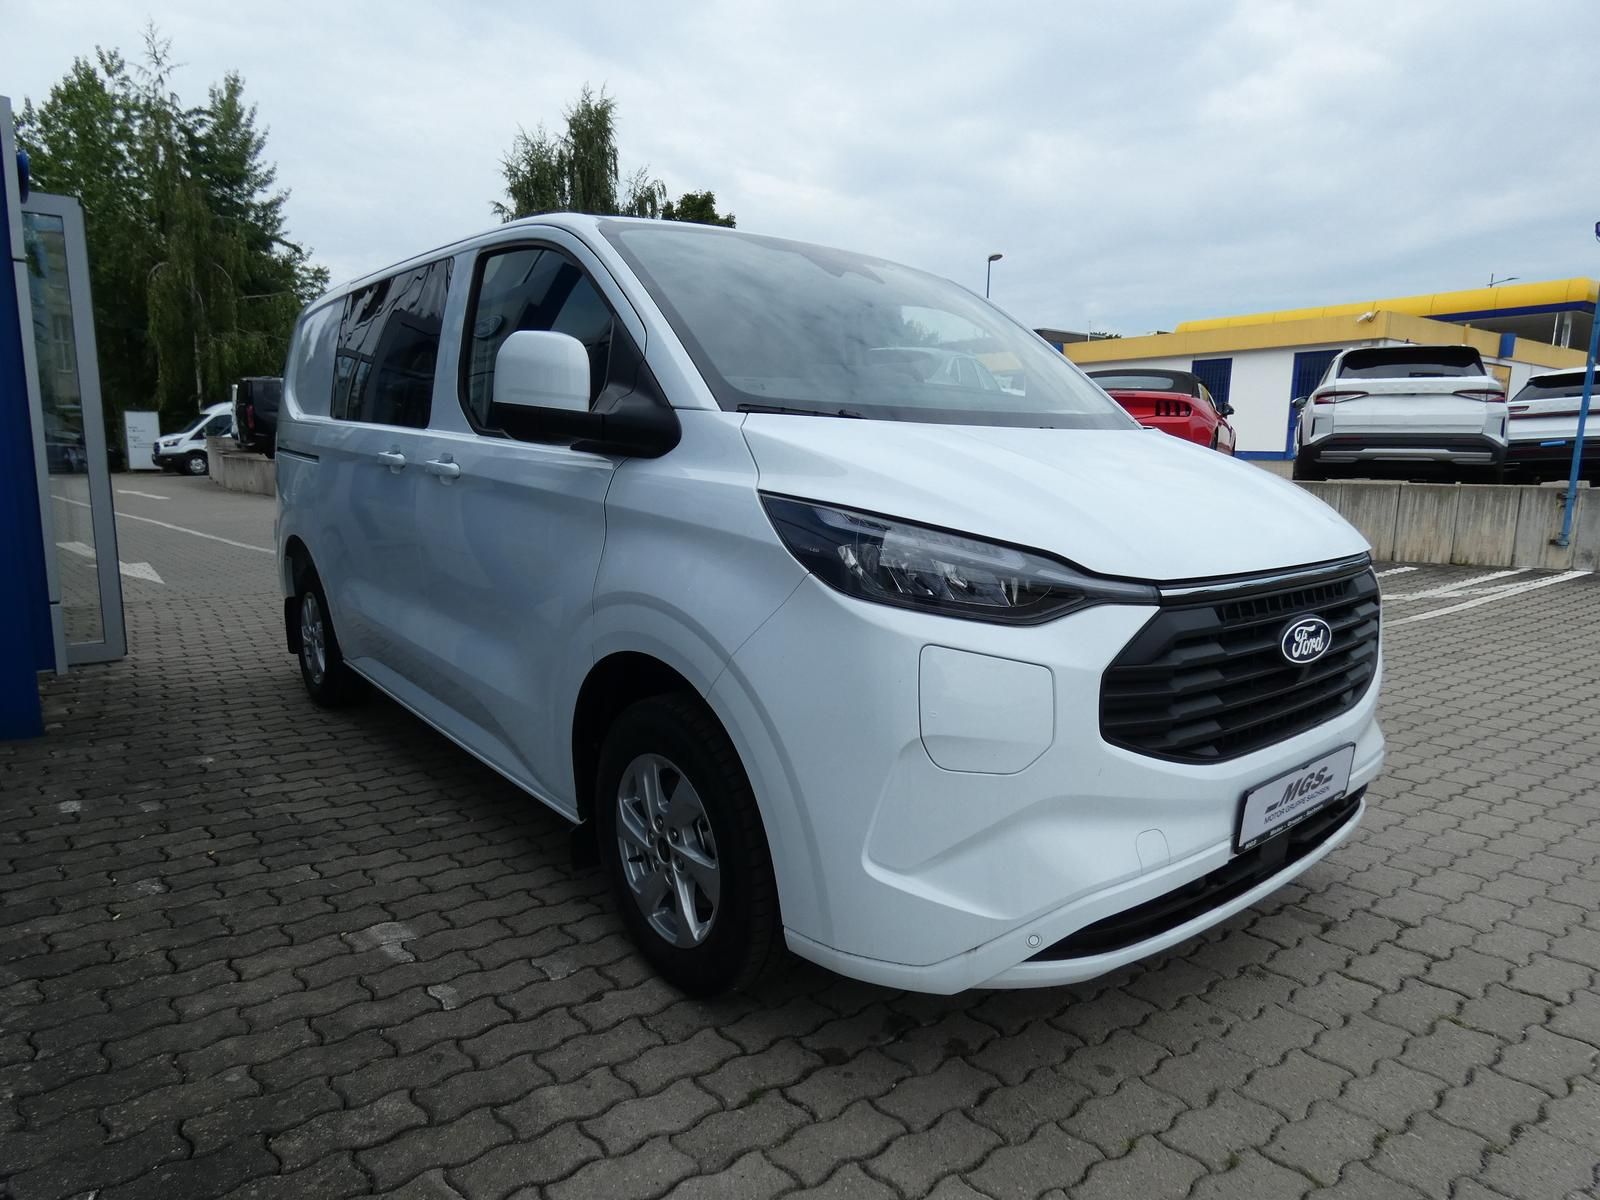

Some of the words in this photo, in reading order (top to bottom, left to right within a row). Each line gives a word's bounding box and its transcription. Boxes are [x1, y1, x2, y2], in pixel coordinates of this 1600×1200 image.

[1292, 624, 1324, 658] Ford
[1278, 766, 1328, 807] MGS
[1264, 808, 1284, 824] MOTOR
